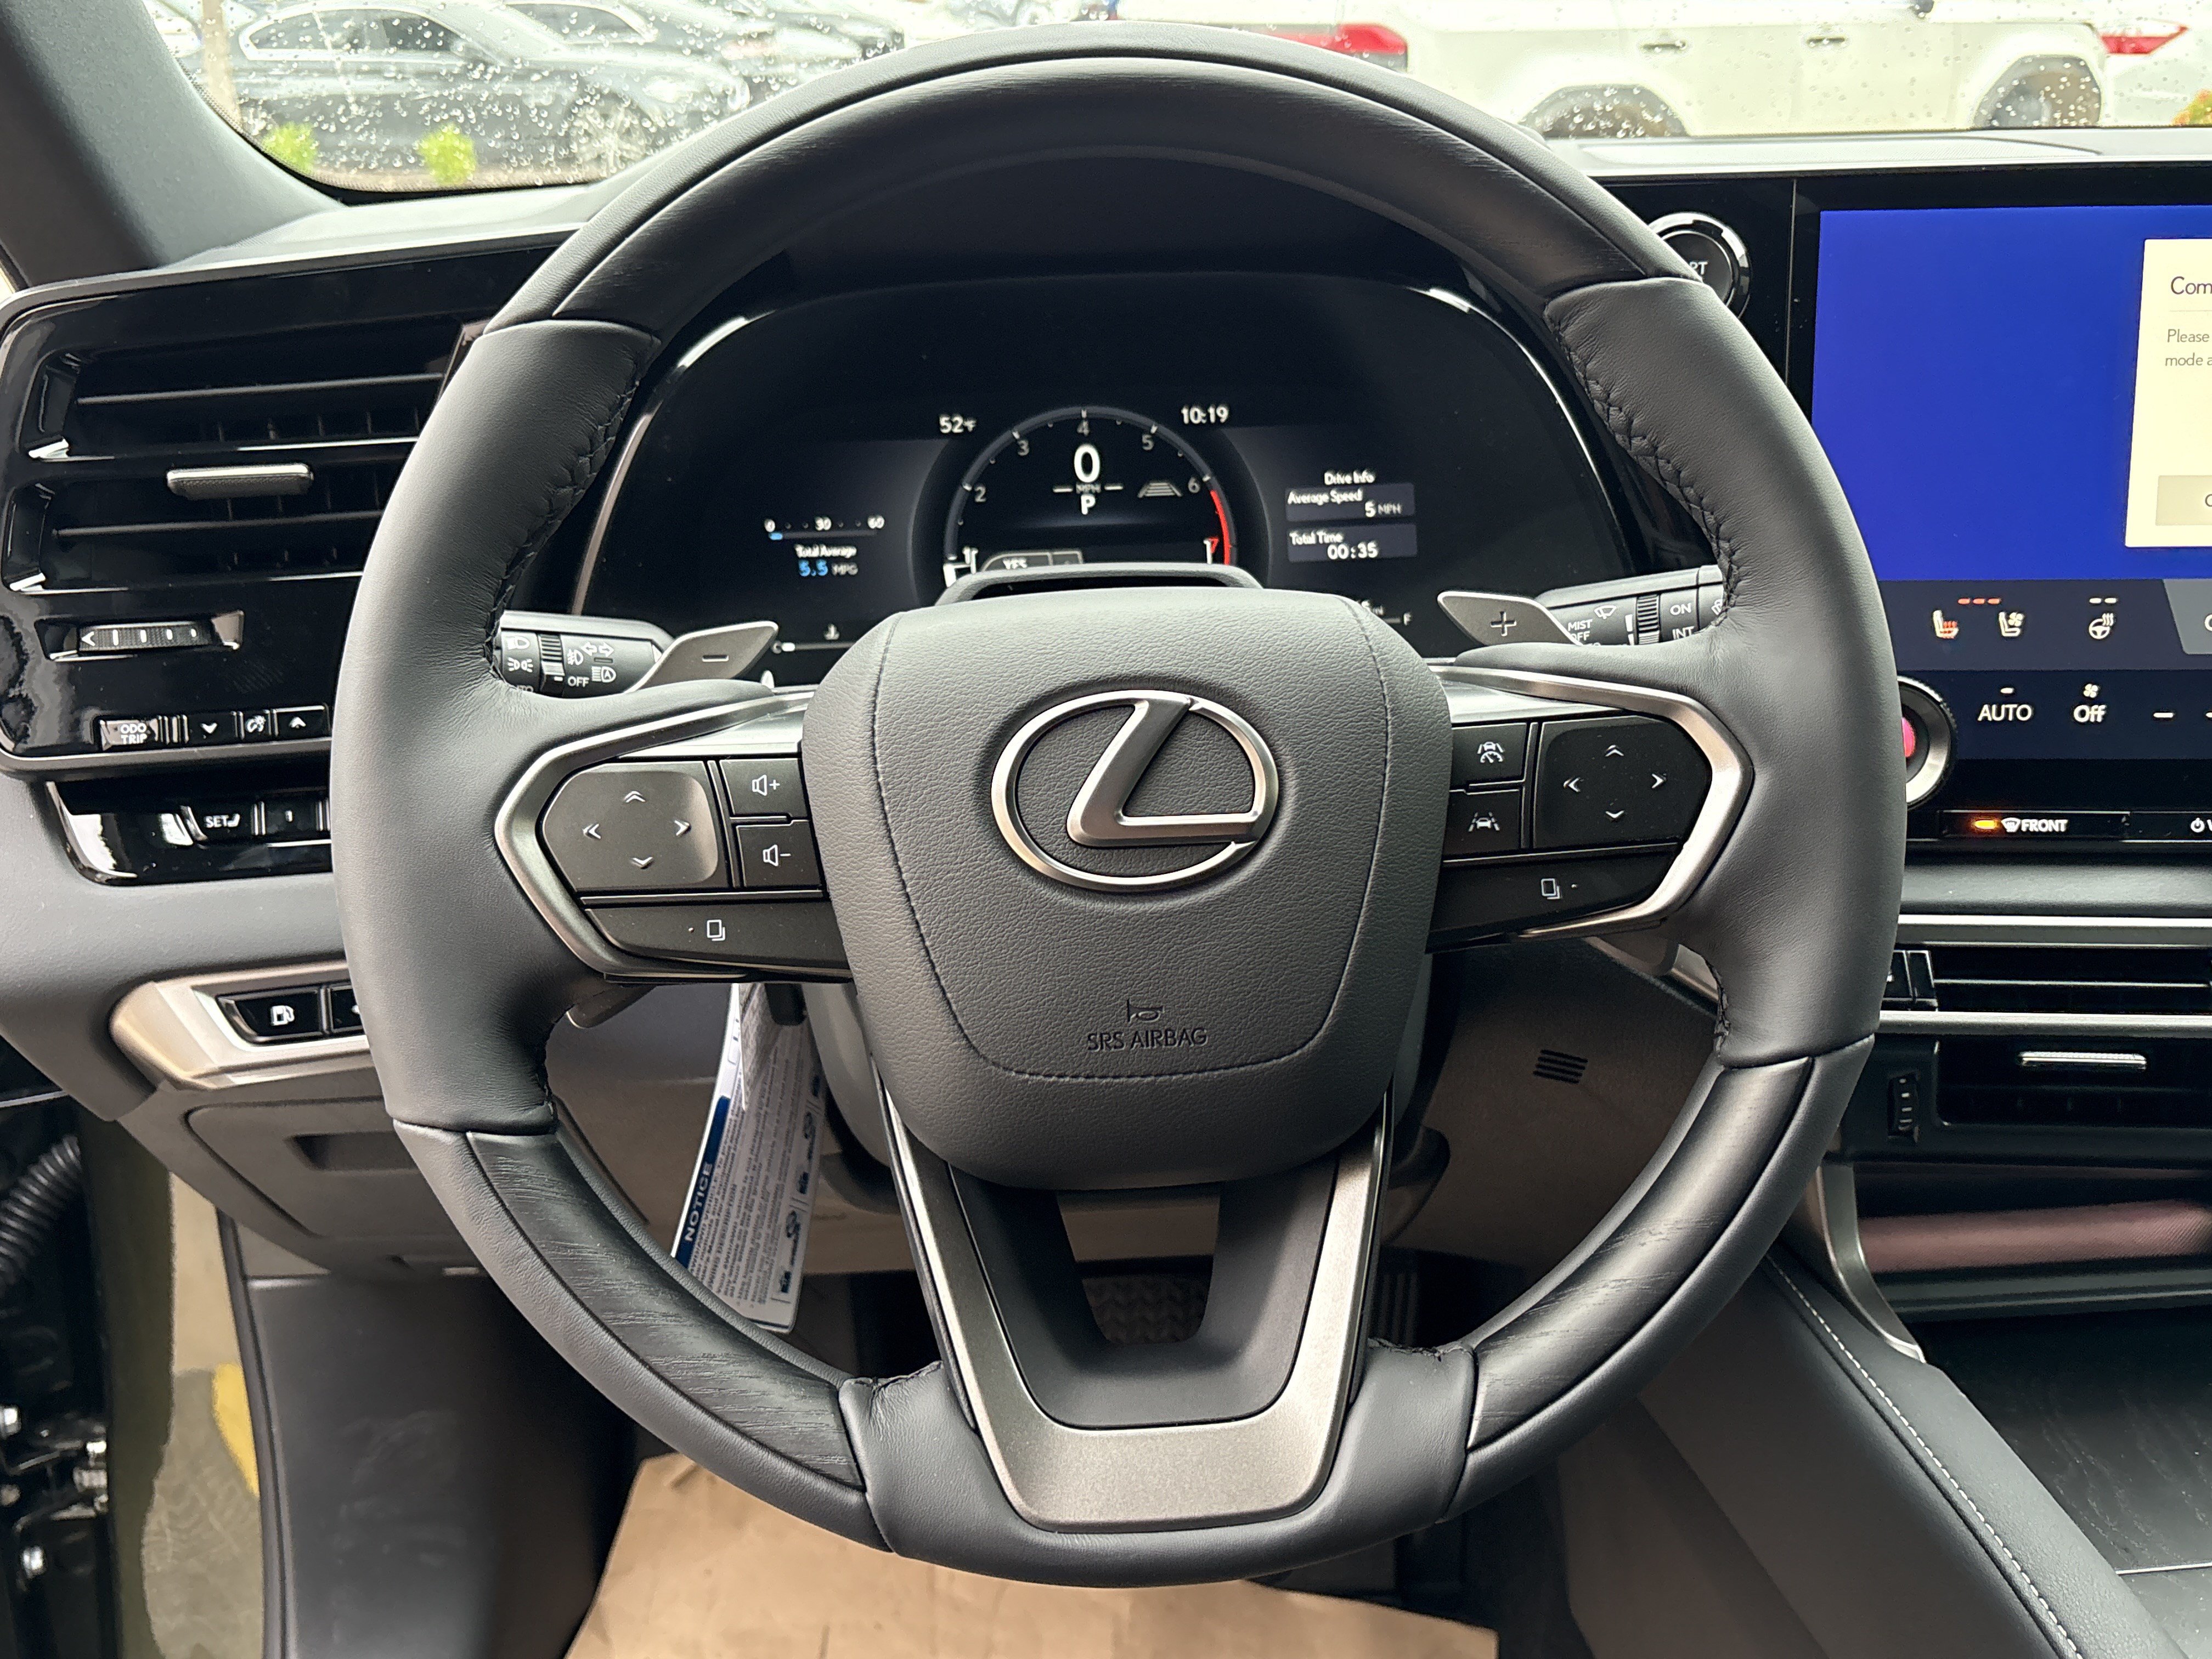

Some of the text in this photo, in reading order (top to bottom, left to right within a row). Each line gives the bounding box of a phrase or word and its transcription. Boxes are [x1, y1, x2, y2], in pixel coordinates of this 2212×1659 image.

[2168, 329, 2209, 342] Please
[2165, 352, 2203, 366] mode
[1181, 405, 1229, 424] 10:19
[1077, 420, 1090, 436] 4
[1017, 439, 1029, 456] 3
[1142, 434, 1154, 450] 5
[1074, 443, 1100, 483] 0
[1188, 476, 1200, 493] 6
[1324, 470, 1375, 485] Drive Info
[974, 485, 986, 503] 2
[1288, 487, 1363, 505] Average Speed
[1080, 494, 1096, 515] P
[1365, 500, 1376, 517] 5
[1289, 528, 1344, 545] Total Time
[1327, 541, 1379, 560] 00:35
[1670, 603, 1691, 615] ON
[1568, 619, 1593, 631] MIST
[1672, 626, 1695, 640] INT
[567, 676, 590, 687] OFF
[1978, 704, 2033, 721] AUTO
[2073, 704, 2107, 723] Off
[120, 723, 147, 734] ODO
[121, 733, 148, 745] TRIP
[204, 815, 229, 828] SET
[2021, 819, 2068, 832] FRONT
[1087, 1027, 1208, 1052] SRS AIRBAG
[685, 1161, 713, 1243] NOTICE
